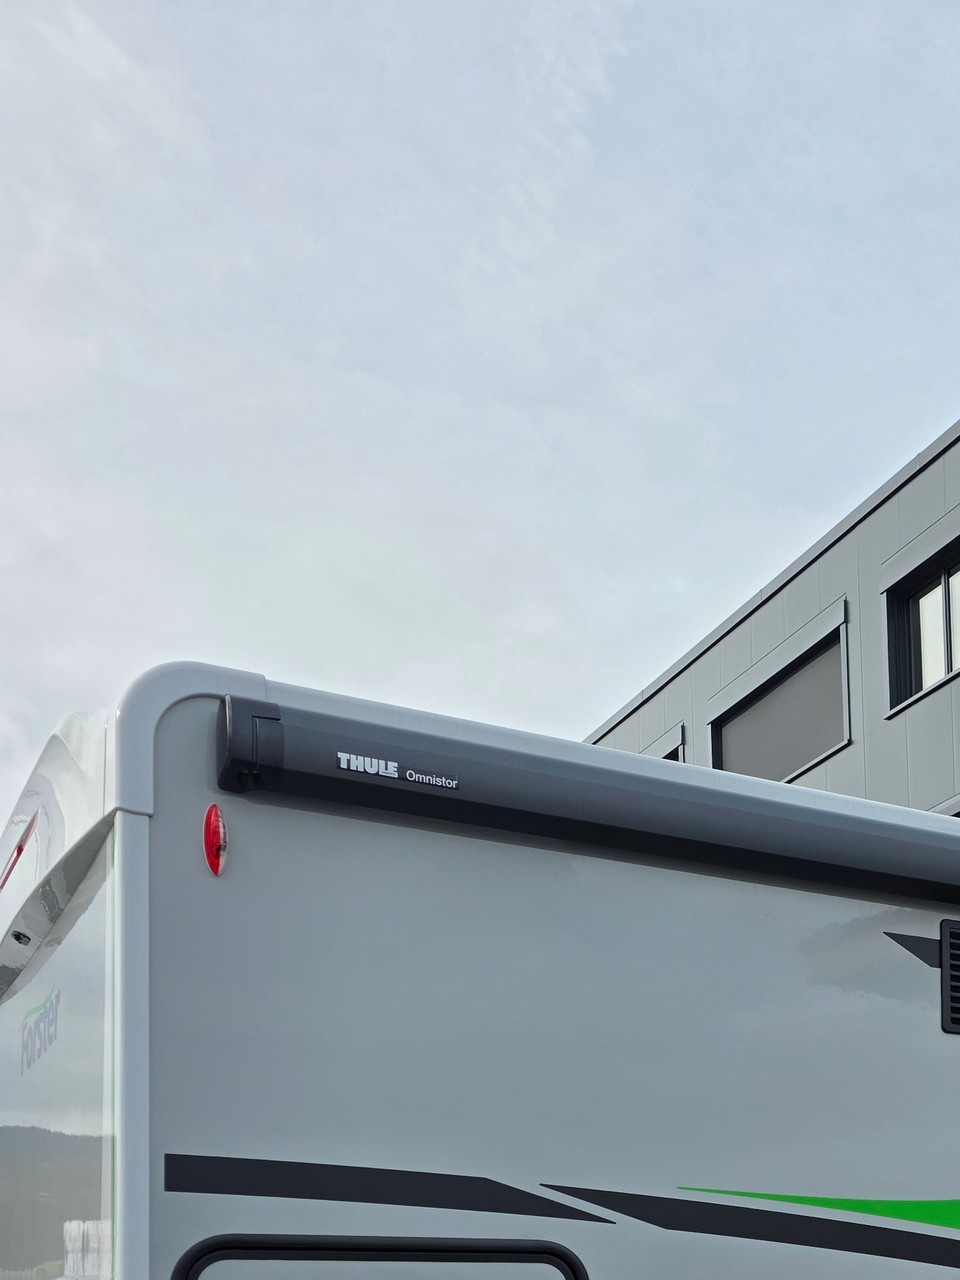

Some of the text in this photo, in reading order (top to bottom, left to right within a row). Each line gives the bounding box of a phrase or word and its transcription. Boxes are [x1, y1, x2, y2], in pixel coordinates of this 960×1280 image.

[337, 751, 458, 789] THULE Omnistor
[20, 989, 61, 1077] Forster
